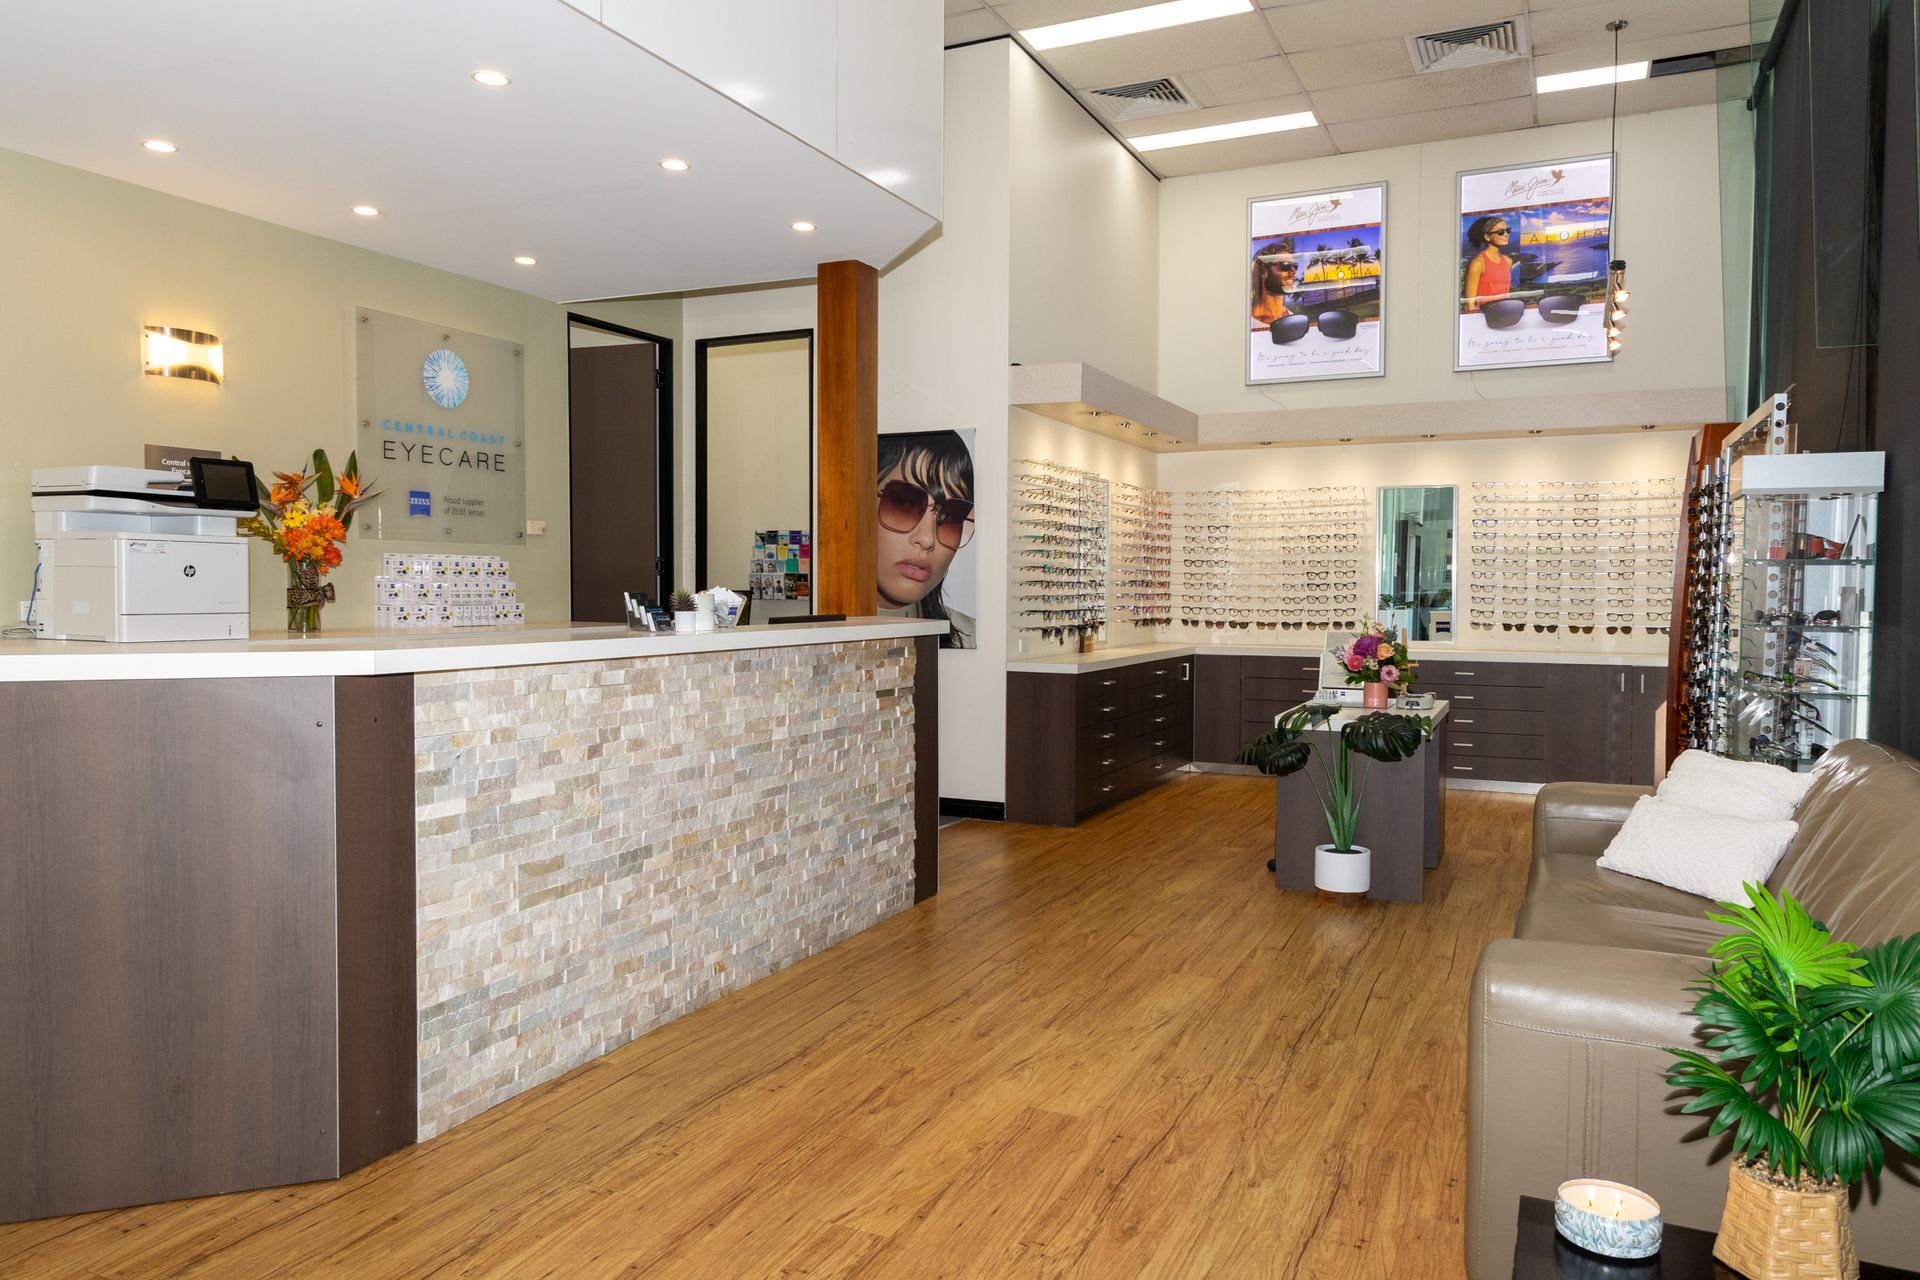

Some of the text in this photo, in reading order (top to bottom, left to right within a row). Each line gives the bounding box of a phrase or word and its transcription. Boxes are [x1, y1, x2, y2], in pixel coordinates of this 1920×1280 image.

[1529, 228, 1603, 245] ALOHA
[1312, 267, 1373, 283] ALOHA
[383, 420, 505, 445] CENTRAL COAST
[161, 458, 187, 467] Central
[383, 440, 506, 472] EYECARE
[443, 496, 485, 508] Proud supplier
[443, 507, 486, 517] of ZEISS lenses
[184, 564, 196, 578] hp
